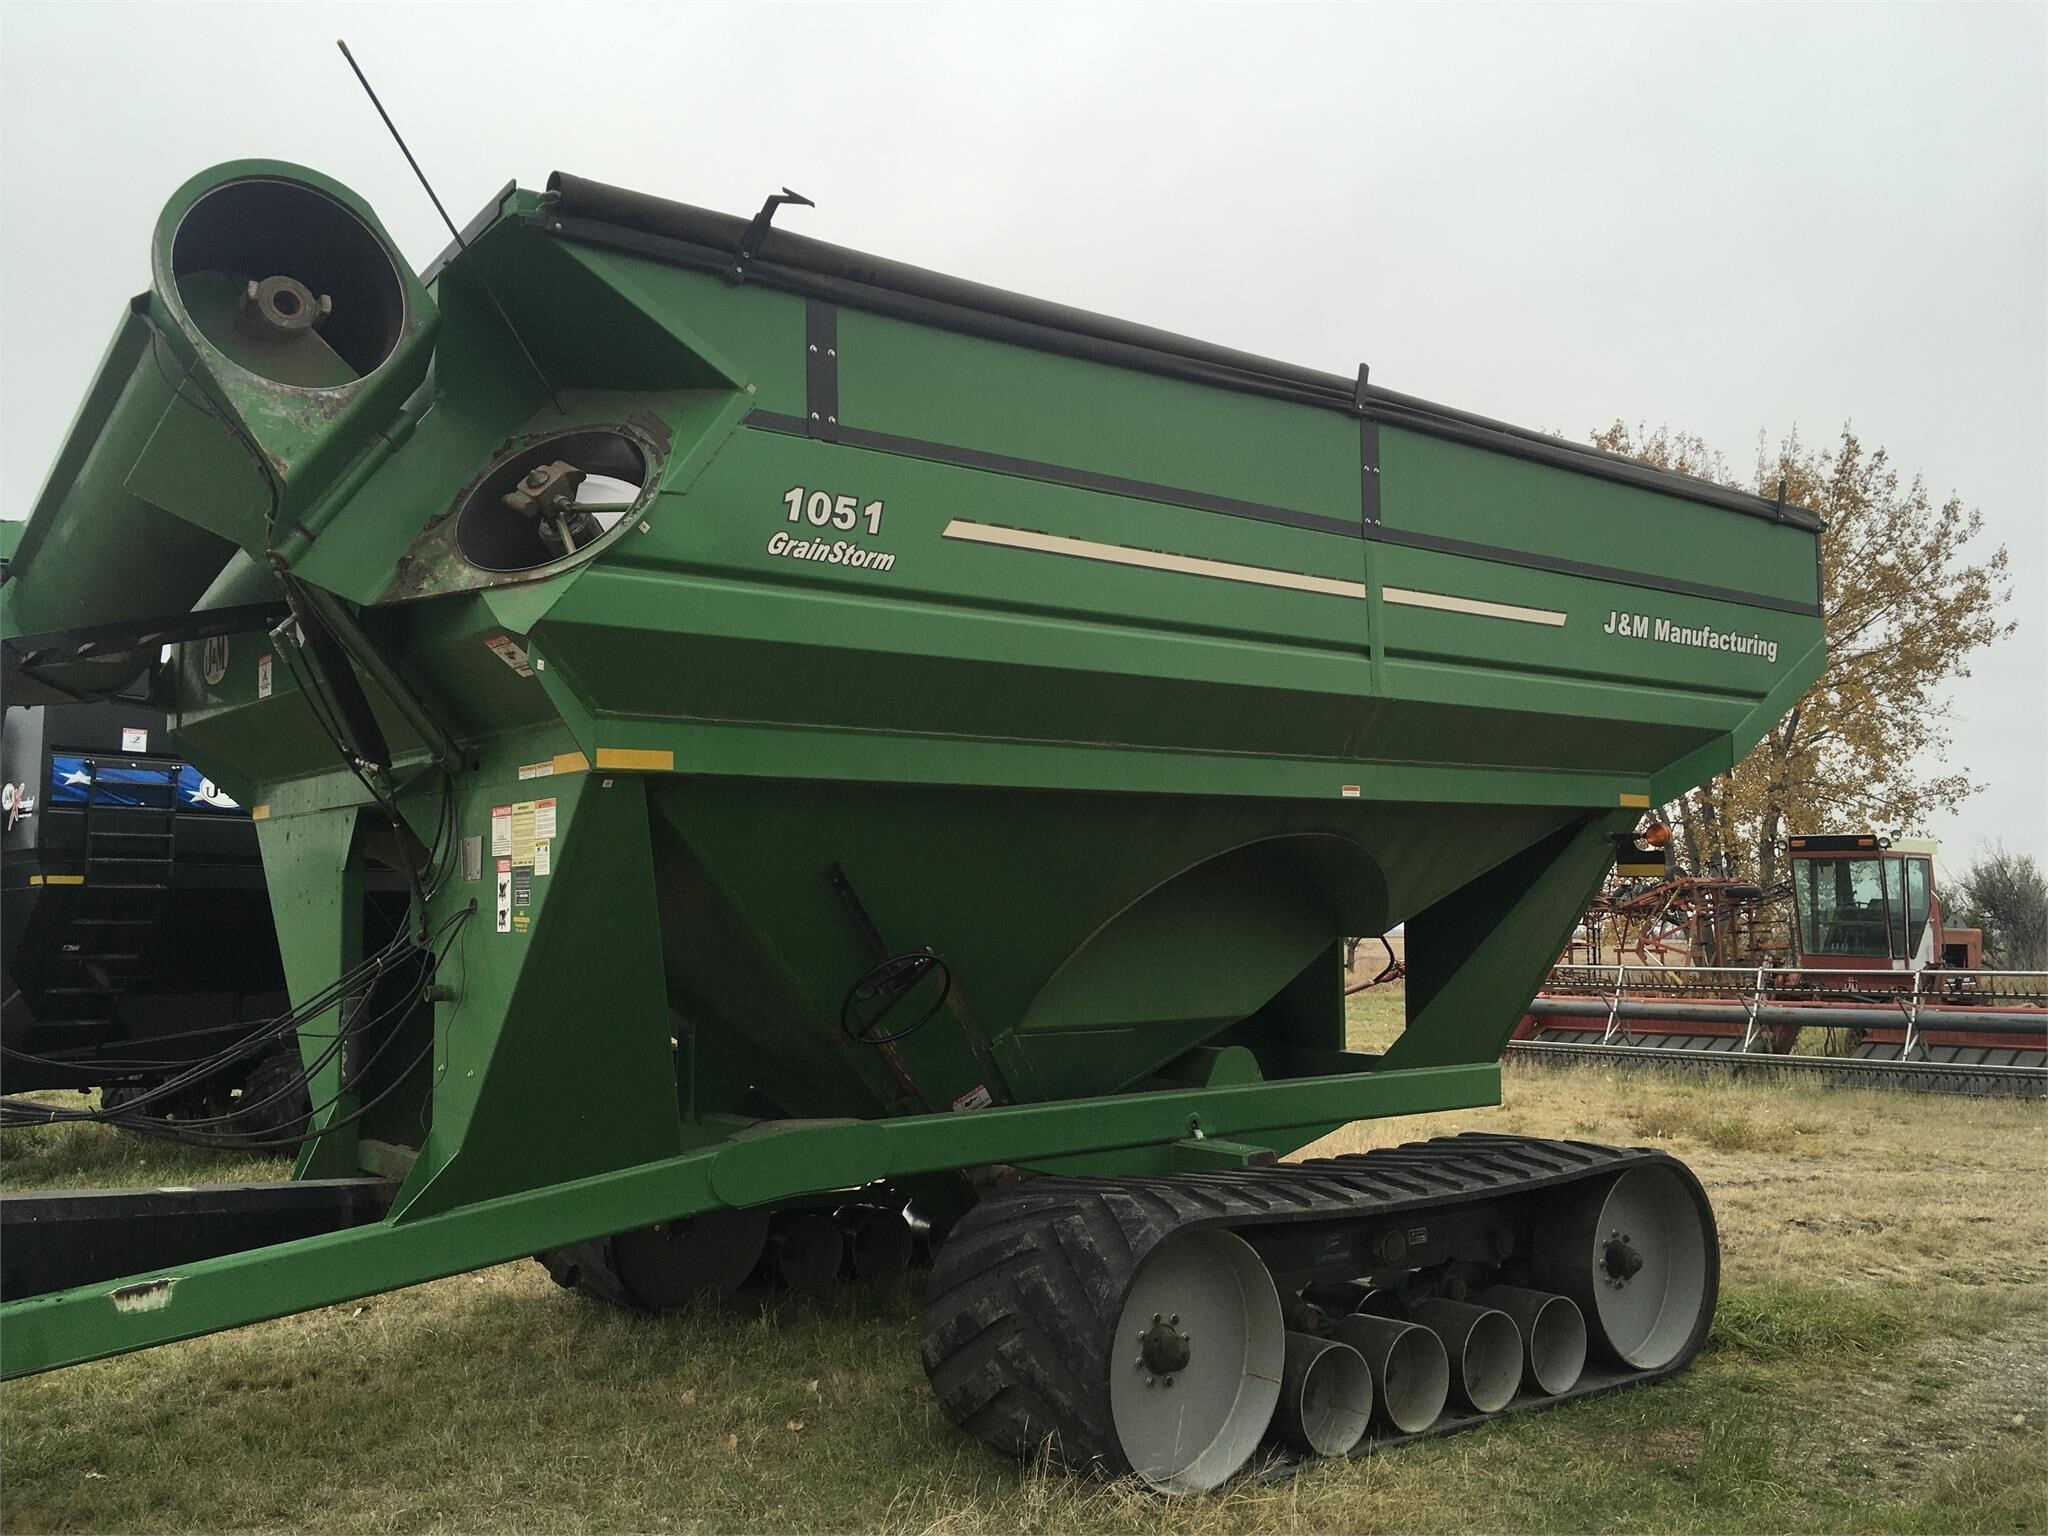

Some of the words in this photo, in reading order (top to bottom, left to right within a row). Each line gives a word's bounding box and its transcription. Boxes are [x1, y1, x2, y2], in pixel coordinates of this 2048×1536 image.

[784, 486, 884, 535] 1051
[767, 531, 896, 571] GrainStorm
[1603, 610, 1649, 639] J&M
[1653, 617, 1778, 662] Manufacturing
